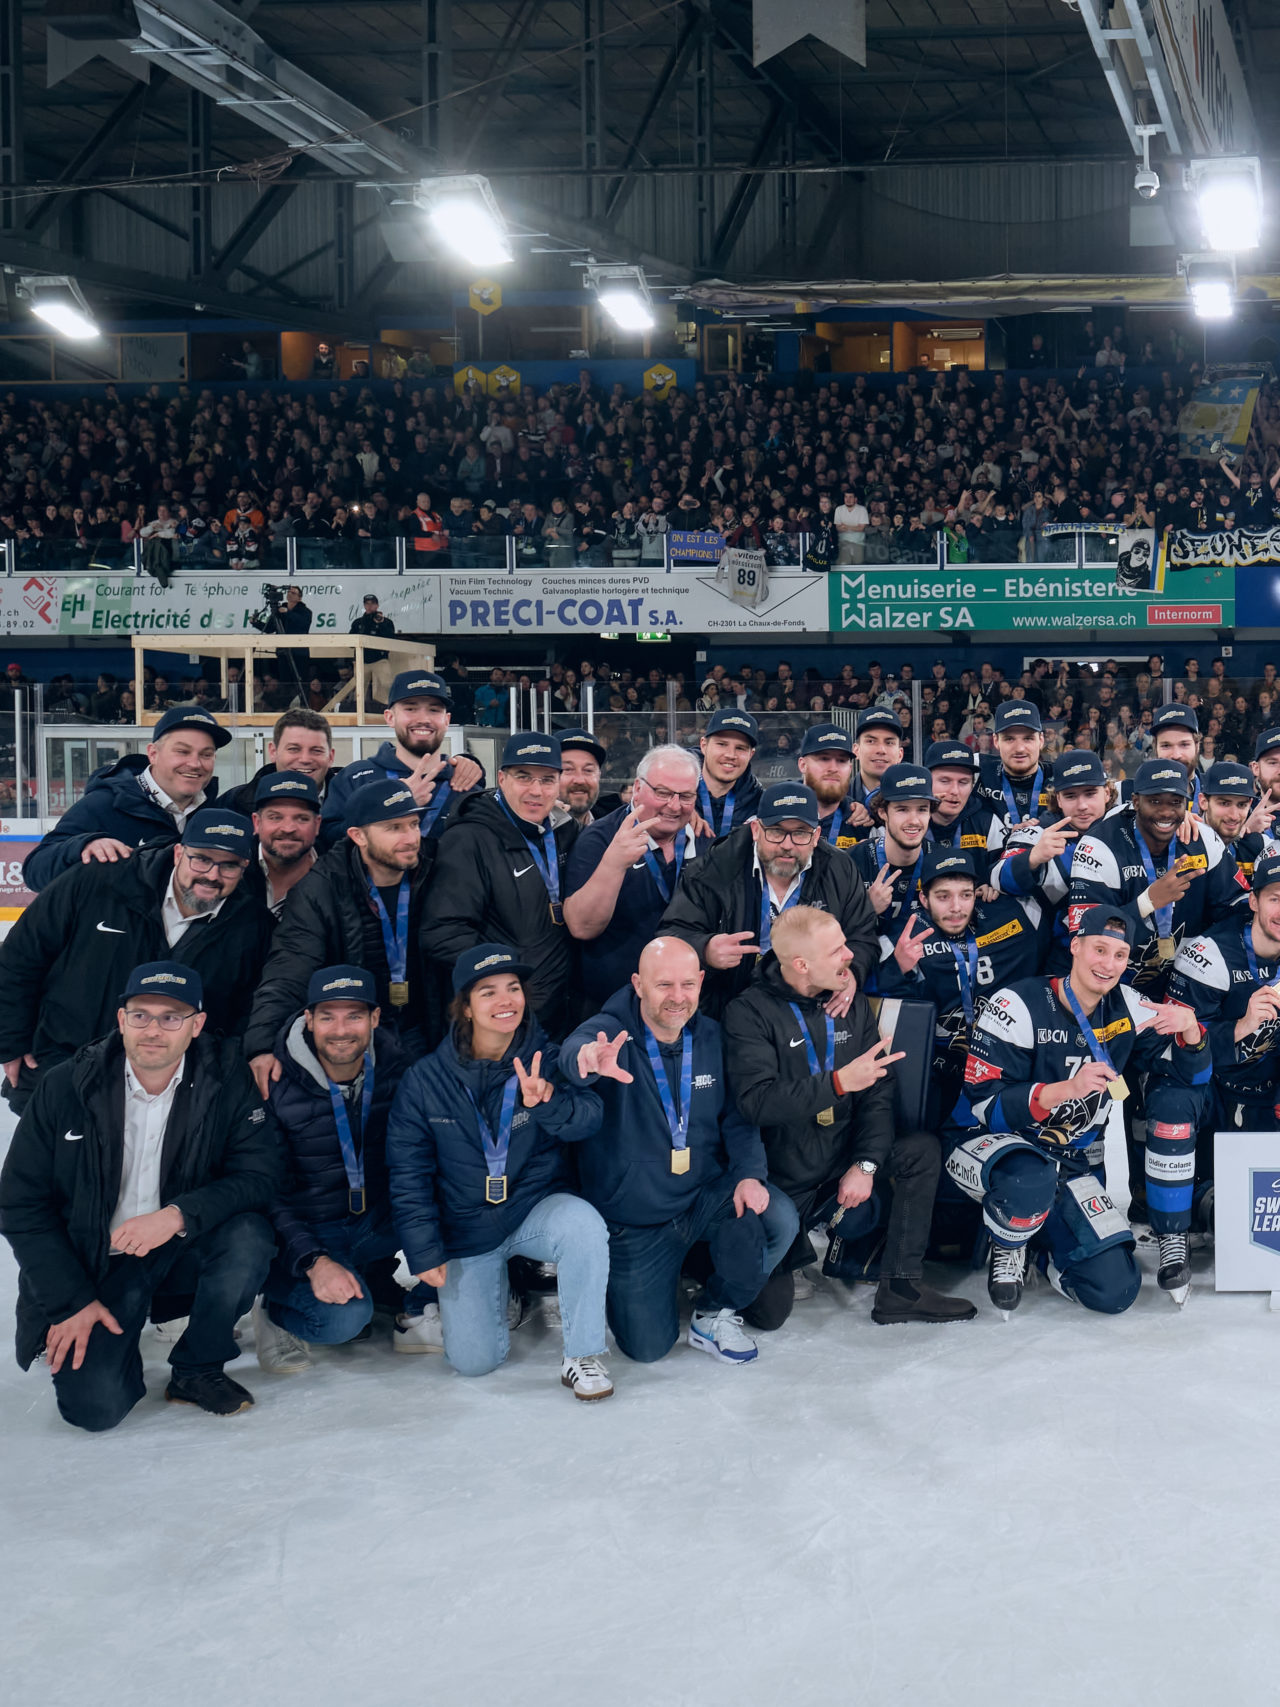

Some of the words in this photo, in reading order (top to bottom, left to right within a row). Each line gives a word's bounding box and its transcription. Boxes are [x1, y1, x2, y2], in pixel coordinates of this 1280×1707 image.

[672, 534, 683, 543] ON
[687, 535, 701, 543] EST
[704, 536, 719, 544] LES
[670, 548, 713, 559] CHAMPIONS
[488, 578, 532, 587] Technology
[737, 568, 756, 586] 89
[96, 583, 143, 596] Courant
[542, 587, 600, 595] Galvanoplastie
[602, 587, 639, 596] horlogère
[651, 587, 690, 595] technique
[841, 574, 976, 599] Menuiserie
[92, 608, 191, 629] Electricité
[316, 612, 337, 628] sa
[448, 597, 644, 627] PRECI-COAT
[649, 610, 684, 626] S.A.
[841, 603, 932, 628] Walzer
[940, 607, 975, 628] SA
[1012, 613, 1136, 626] www.walzersa.ch
[1155, 609, 1213, 620] Internorm
[1073, 853, 1102, 870] SSOT
[924, 941, 953, 956] BCN
[1181, 945, 1212, 968] SSOT
[987, 1003, 1016, 1026] SSOT
